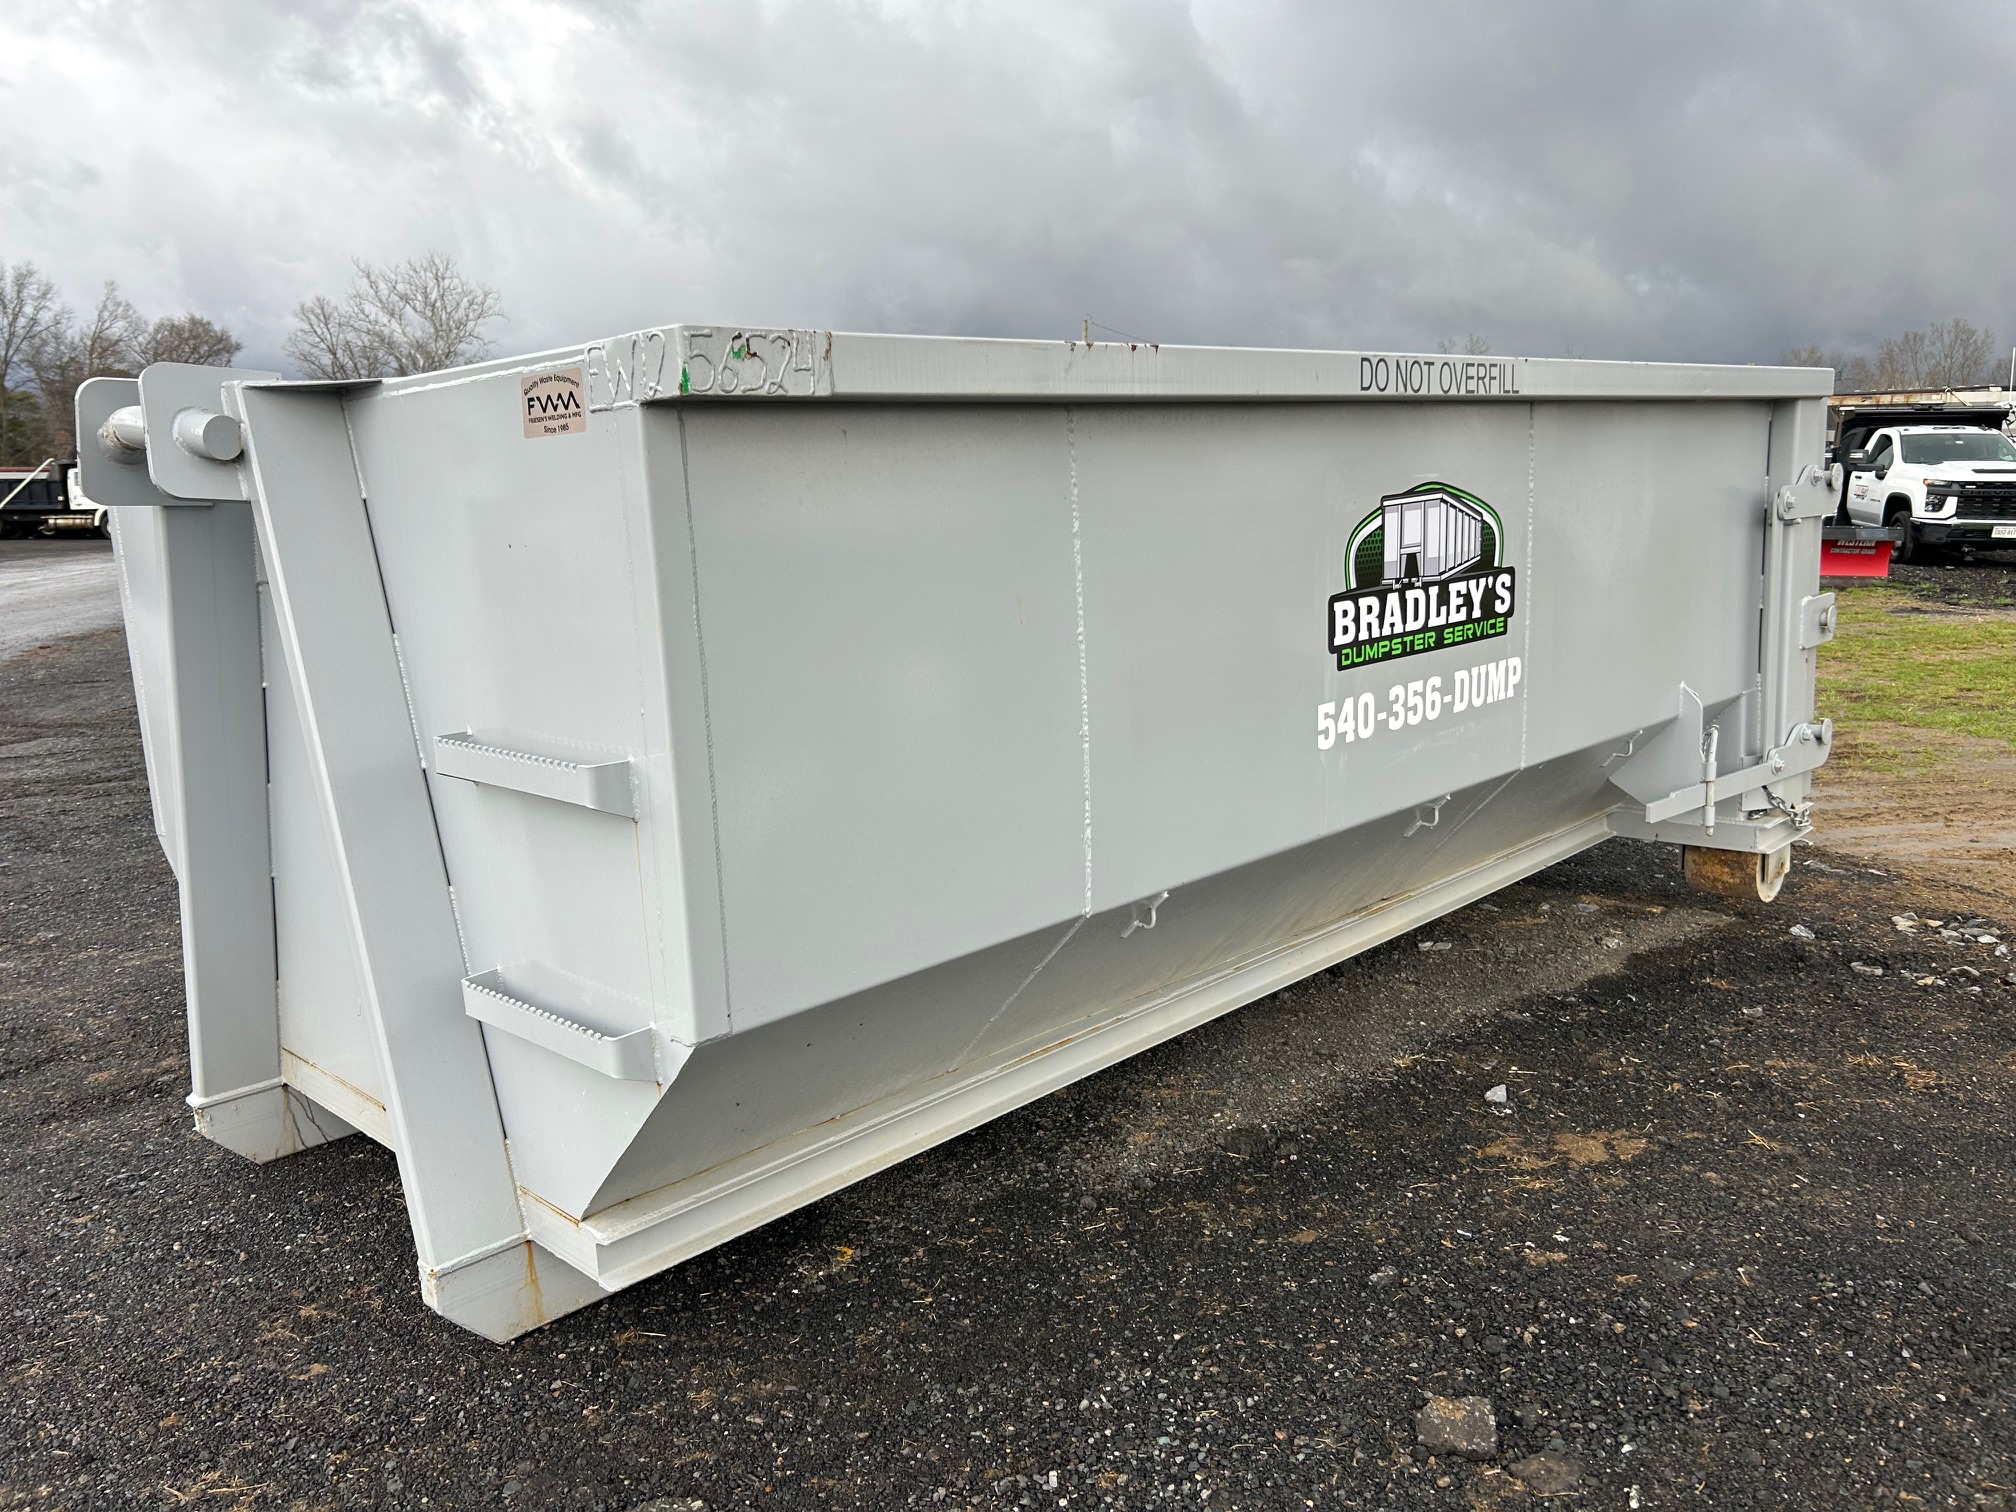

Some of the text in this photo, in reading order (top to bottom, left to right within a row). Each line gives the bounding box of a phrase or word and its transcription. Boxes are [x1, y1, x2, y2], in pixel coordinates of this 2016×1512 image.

[523, 374, 579, 396] Quality Waste Equipment
[1360, 357, 1520, 395] DO NOT OVERFILL
[527, 391, 581, 415] FWM
[543, 425, 557, 433] Since
[1333, 573, 1512, 646] BRADLEY'S
[1341, 617, 1505, 666] DUMPSTER SERVICE
[1317, 656, 1522, 750] 540-356-DUMP
